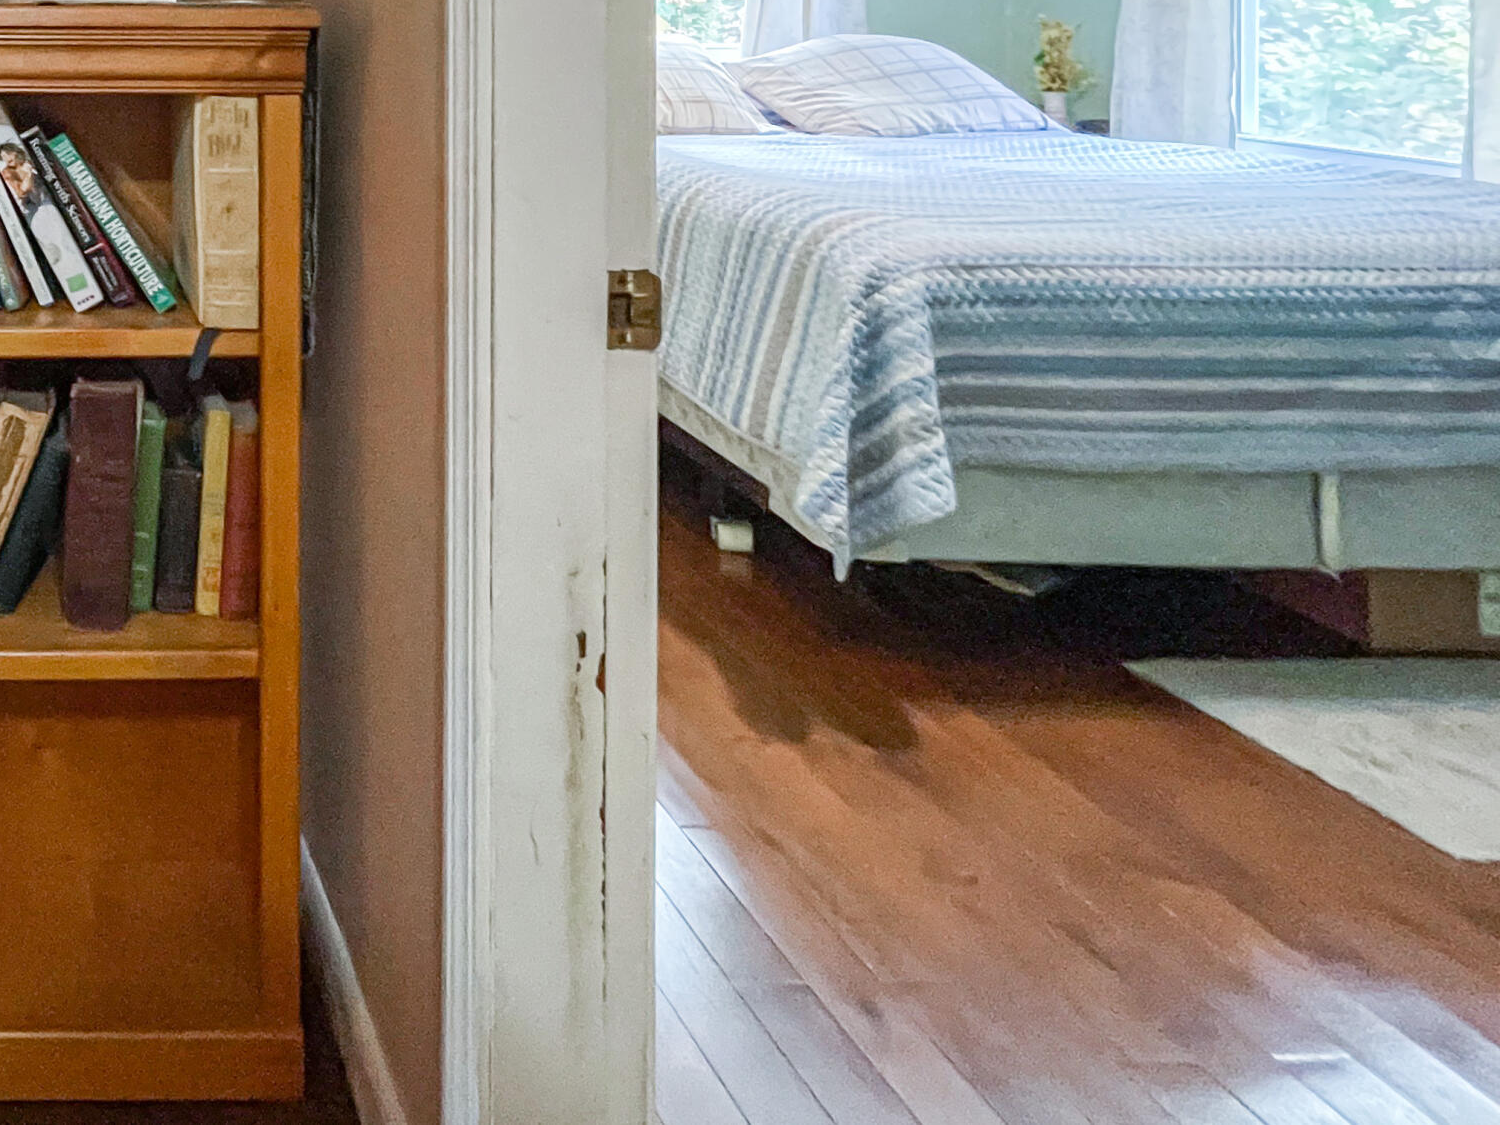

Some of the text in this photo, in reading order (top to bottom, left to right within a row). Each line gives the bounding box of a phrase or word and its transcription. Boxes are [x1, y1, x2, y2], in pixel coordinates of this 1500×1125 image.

[28, 136, 57, 182] Running
[51, 178, 72, 204] with
[64, 203, 93, 243] Scissors
[65, 159, 115, 222] MARIJUANA
[104, 217, 164, 296] HORTICULTURE
